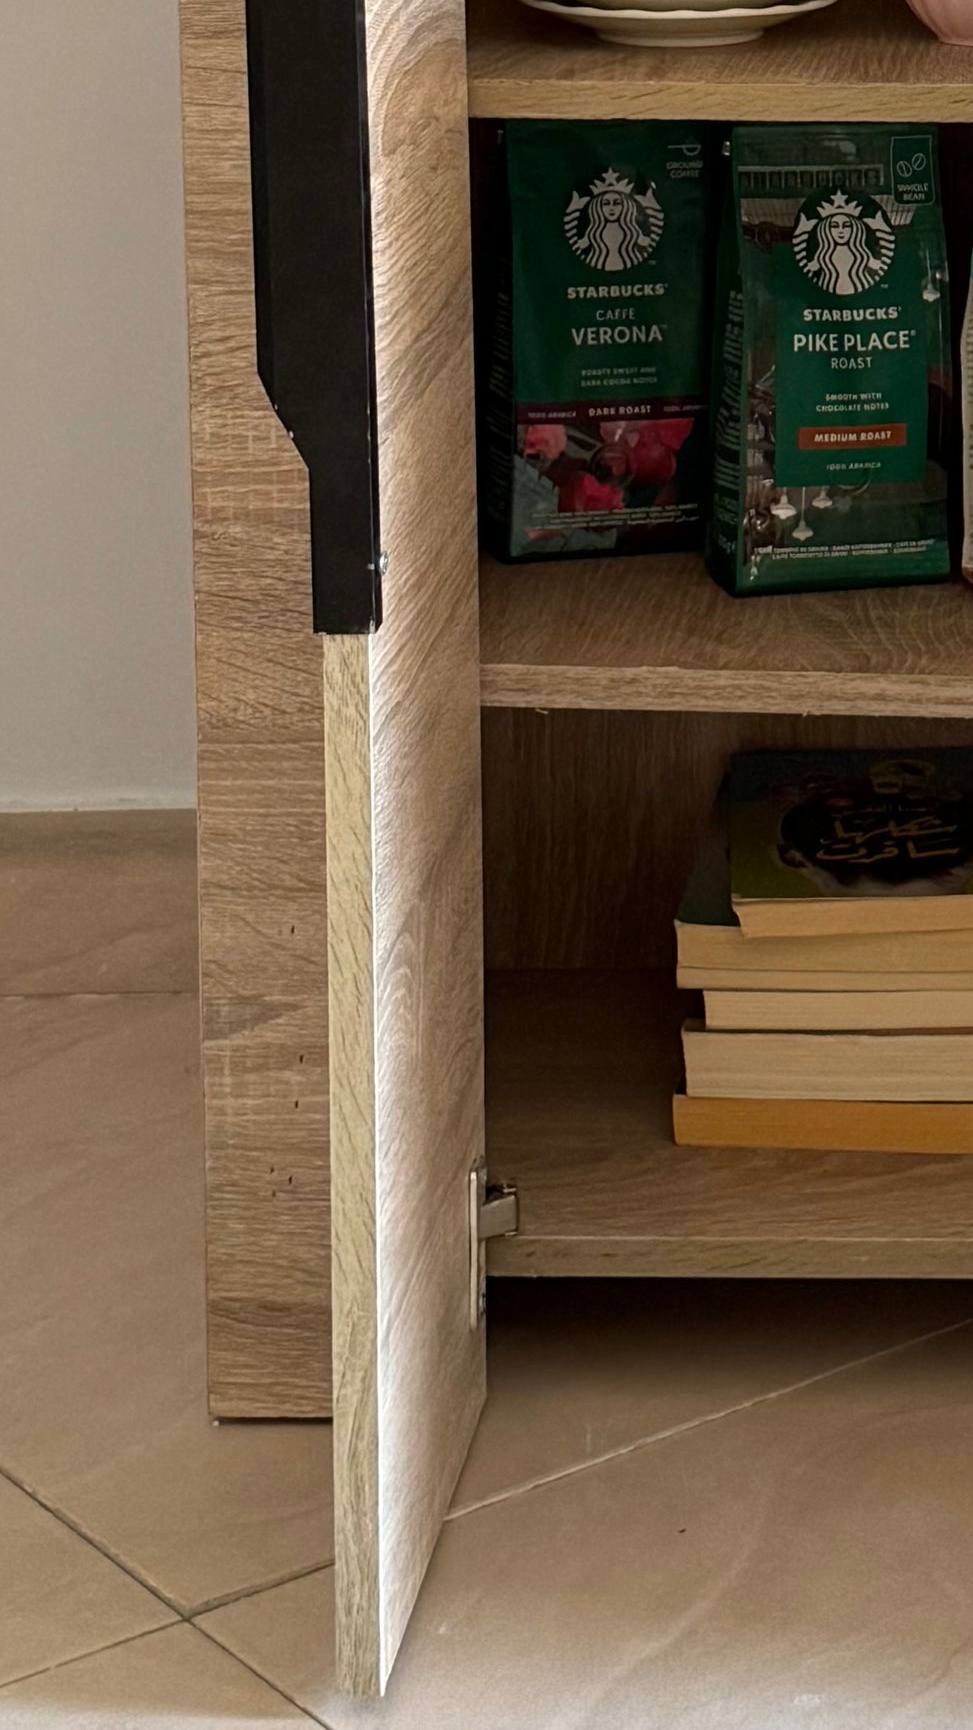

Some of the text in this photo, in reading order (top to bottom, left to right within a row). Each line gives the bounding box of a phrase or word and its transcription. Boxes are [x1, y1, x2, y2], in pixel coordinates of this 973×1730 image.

[903, 192, 926, 201] BEAN
[566, 283, 666, 299] STARBUCKS
[803, 306, 899, 322] STARBUCKS
[571, 324, 663, 346] VERONA
[793, 329, 911, 352] PIKE PLACE
[831, 356, 873, 370] ROAST
[825, 392, 882, 401] SMOOTH WITH
[588, 404, 652, 418] DARK ROAST
[816, 402, 890, 412] CHOCOLATE NOTES
[814, 431, 892, 442] MEDIUM ROAST
